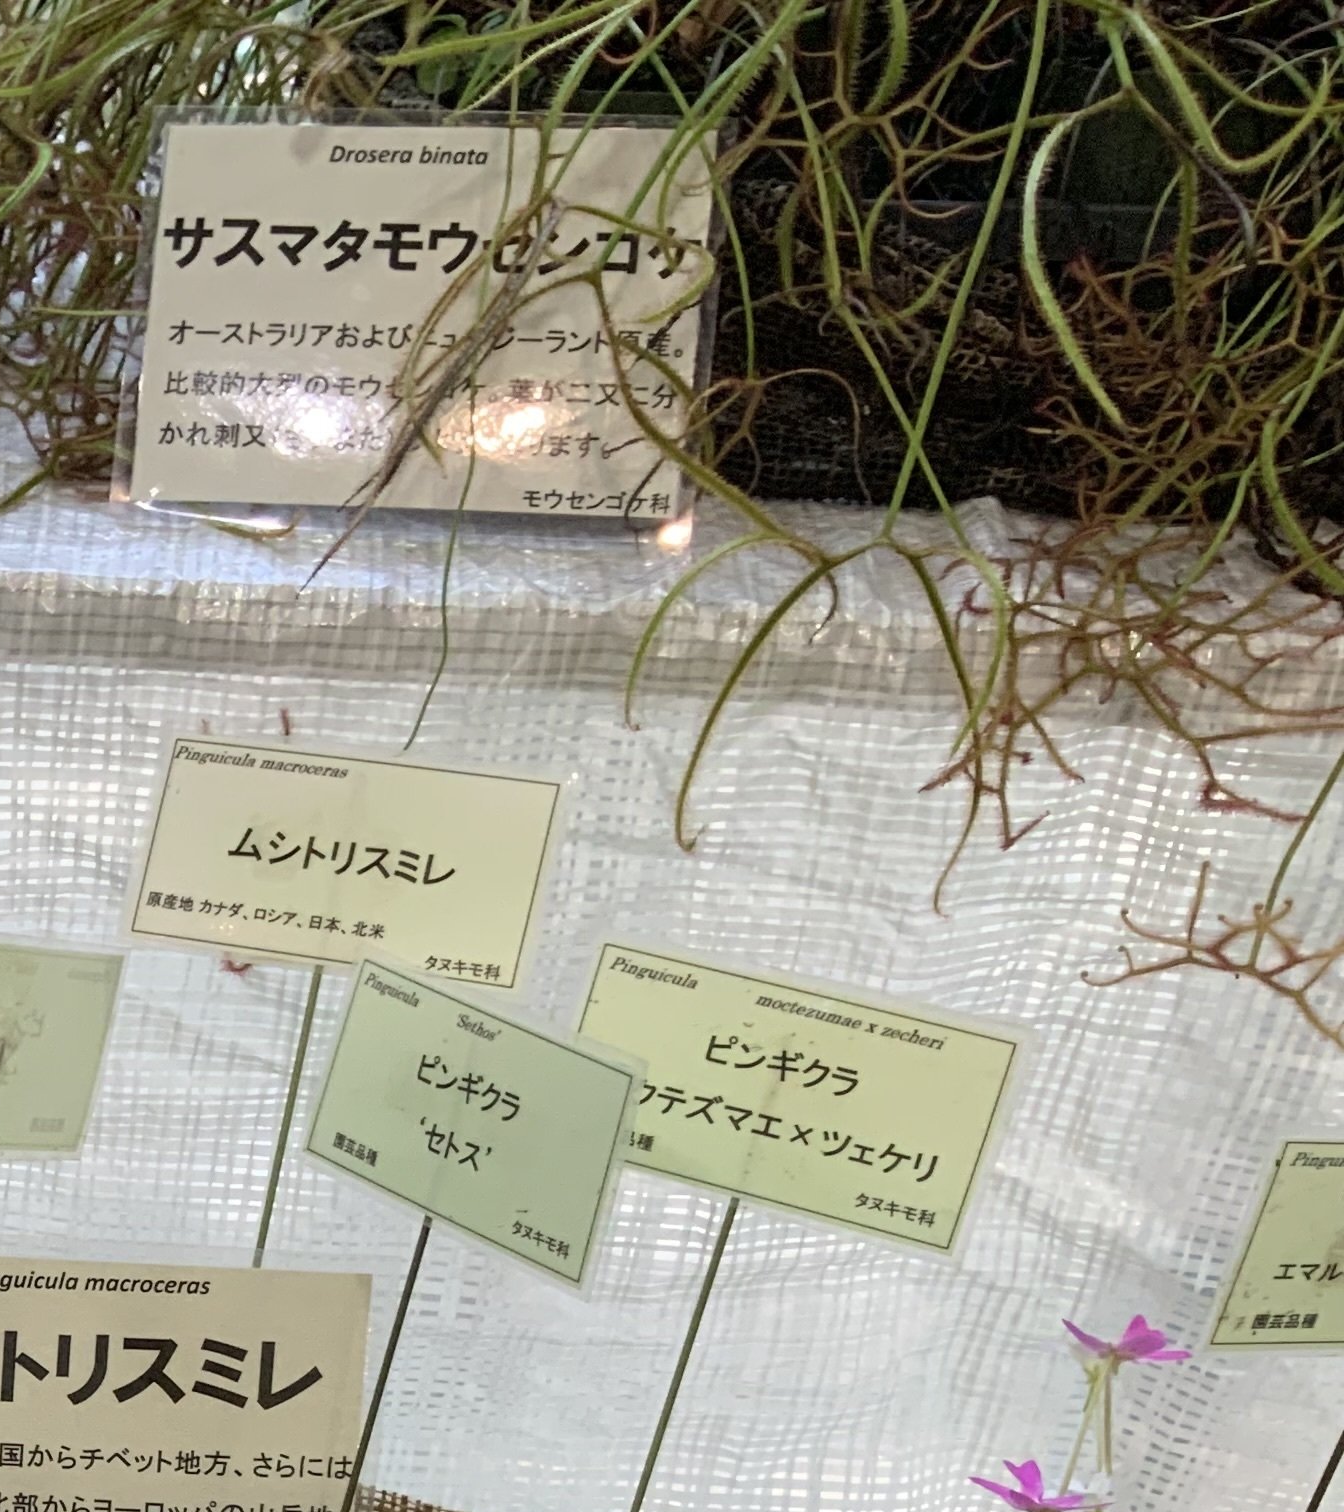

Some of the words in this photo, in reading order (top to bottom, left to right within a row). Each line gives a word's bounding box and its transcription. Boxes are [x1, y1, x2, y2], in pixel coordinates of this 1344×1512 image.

[329, 145, 413, 165] Drosera
[419, 145, 488, 166] binata
[522, 489, 671, 514] モウセンゴケ科
[174, 745, 257, 769] Pinguicula
[259, 757, 349, 780] macroceras
[227, 827, 456, 885] ムシトリスミレ
[146, 891, 194, 913] 原産地
[199, 898, 385, 940] カナダ、ロシア、日本、北米
[424, 955, 502, 982] タヌキモ科
[364, 972, 420, 1008] Pinguicula
[610, 955, 699, 990] Pinguicula
[755, 993, 863, 1030] moctezumae
[880, 1022, 947, 1051] zecheri
[706, 1035, 859, 1096] ピンギクラ
[416, 1054, 520, 1122] ピンギクラ
[854, 1192, 936, 1228] タヌキモ科
[512, 1219, 570, 1260] タヌキモ科
[84, 1273, 211, 1296] macroceras
